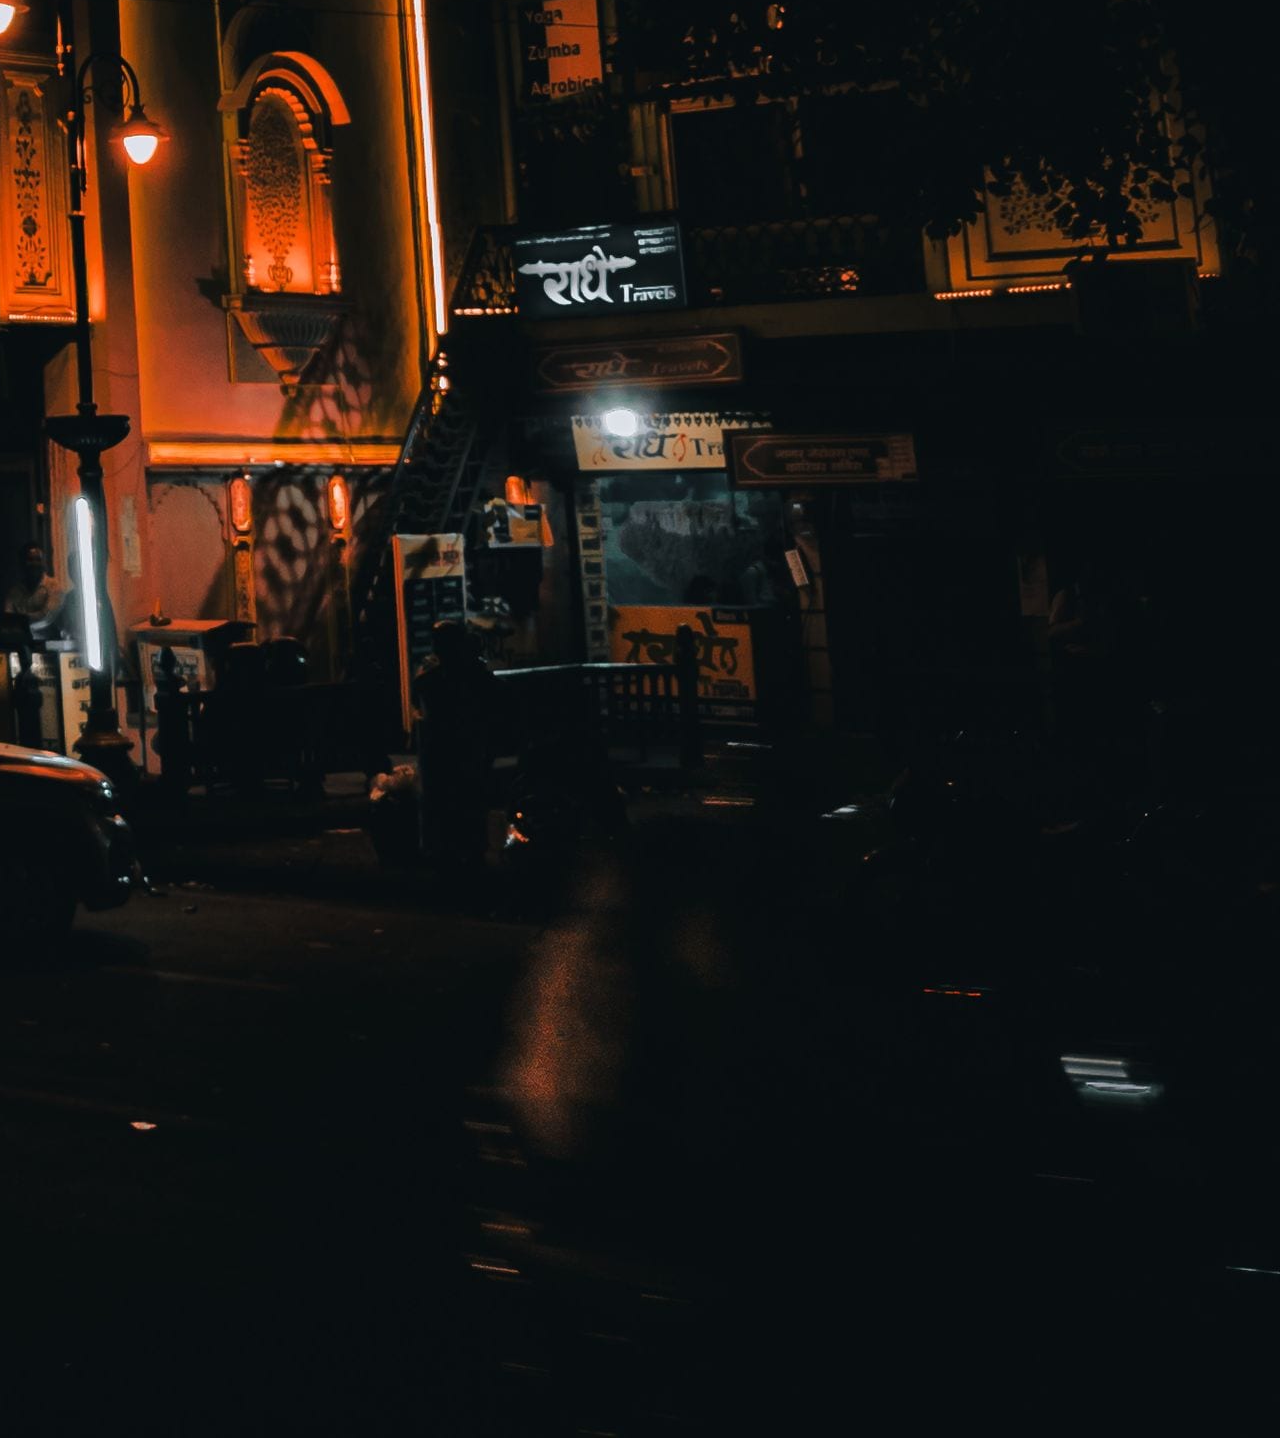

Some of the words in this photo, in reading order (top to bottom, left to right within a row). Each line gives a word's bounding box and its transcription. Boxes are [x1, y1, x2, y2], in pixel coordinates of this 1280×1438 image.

[524, 9, 563, 25] Yoga
[528, 42, 580, 61] Zumba
[518, 245, 637, 305] राधे
[619, 283, 677, 303] Travels
